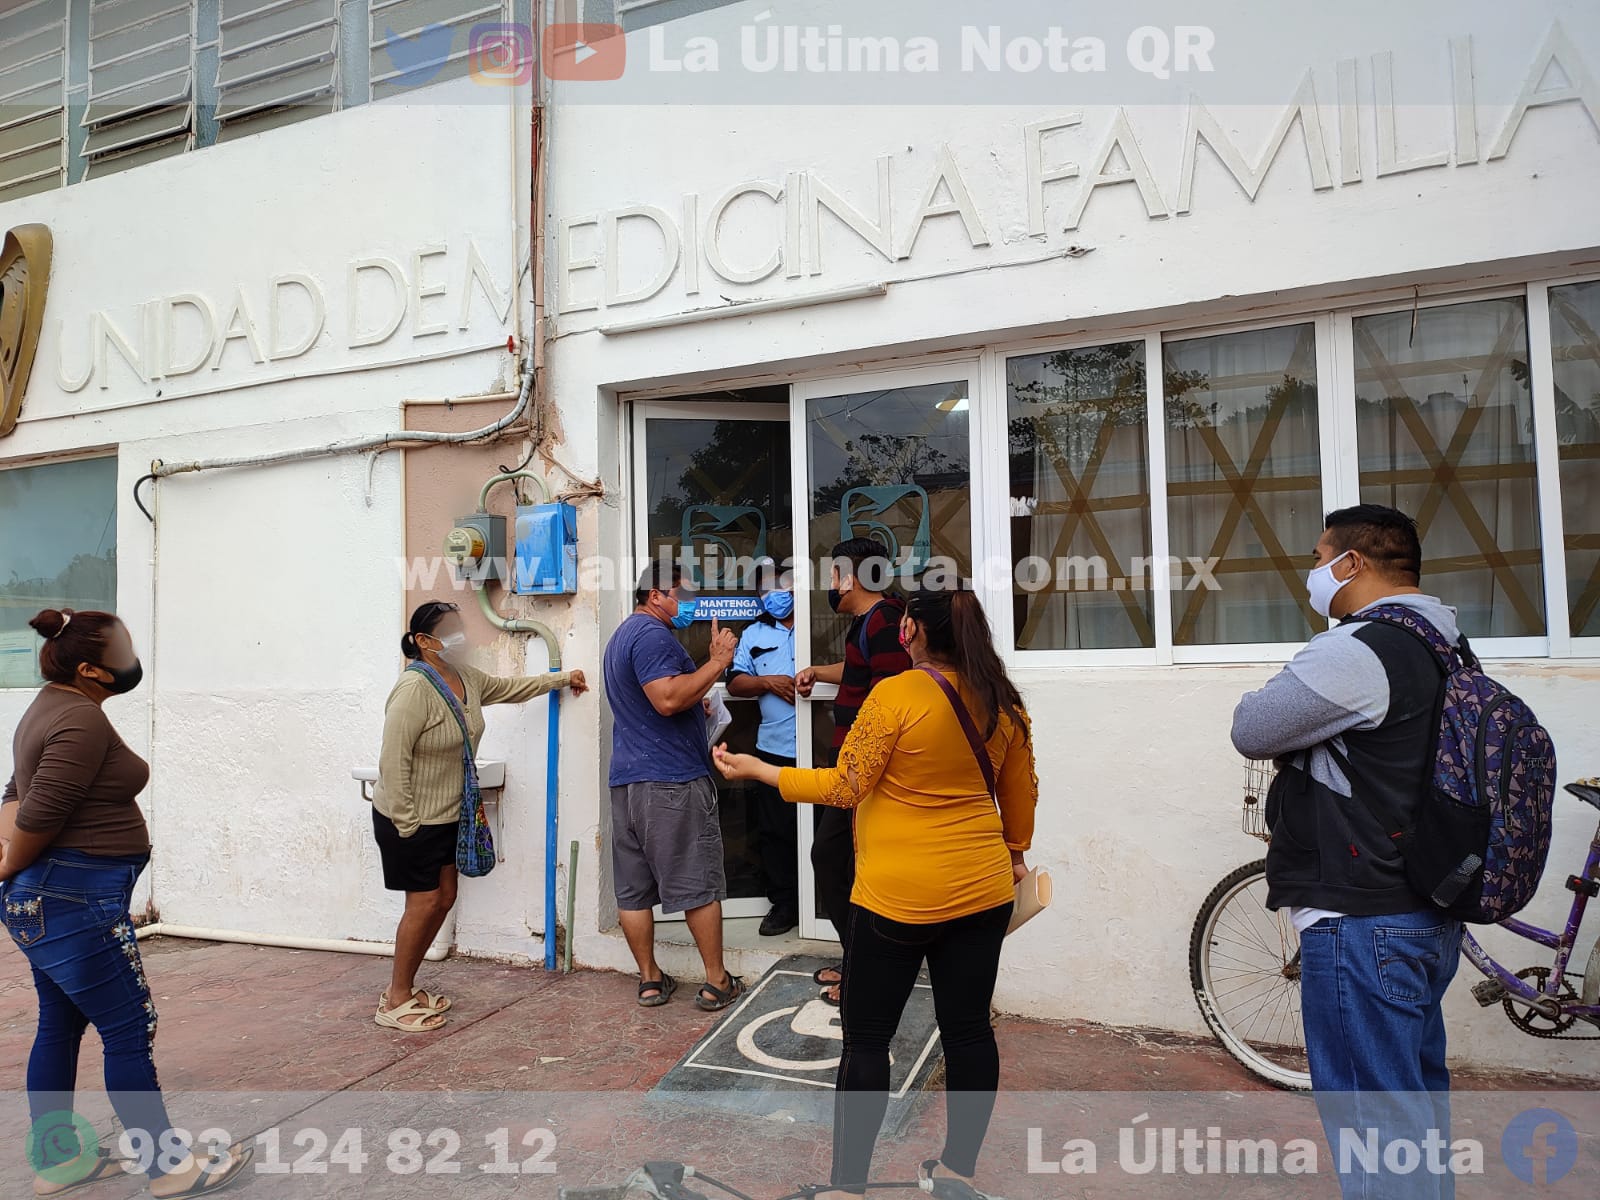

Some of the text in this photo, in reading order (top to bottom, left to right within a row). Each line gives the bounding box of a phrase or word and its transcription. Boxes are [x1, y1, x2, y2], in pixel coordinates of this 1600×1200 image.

[56, 271, 326, 393] UNIDAD
[347, 242, 450, 349] DE
[700, 599, 758, 608] MANTENGA
[694, 609, 763, 617] SU DISTANCIA
